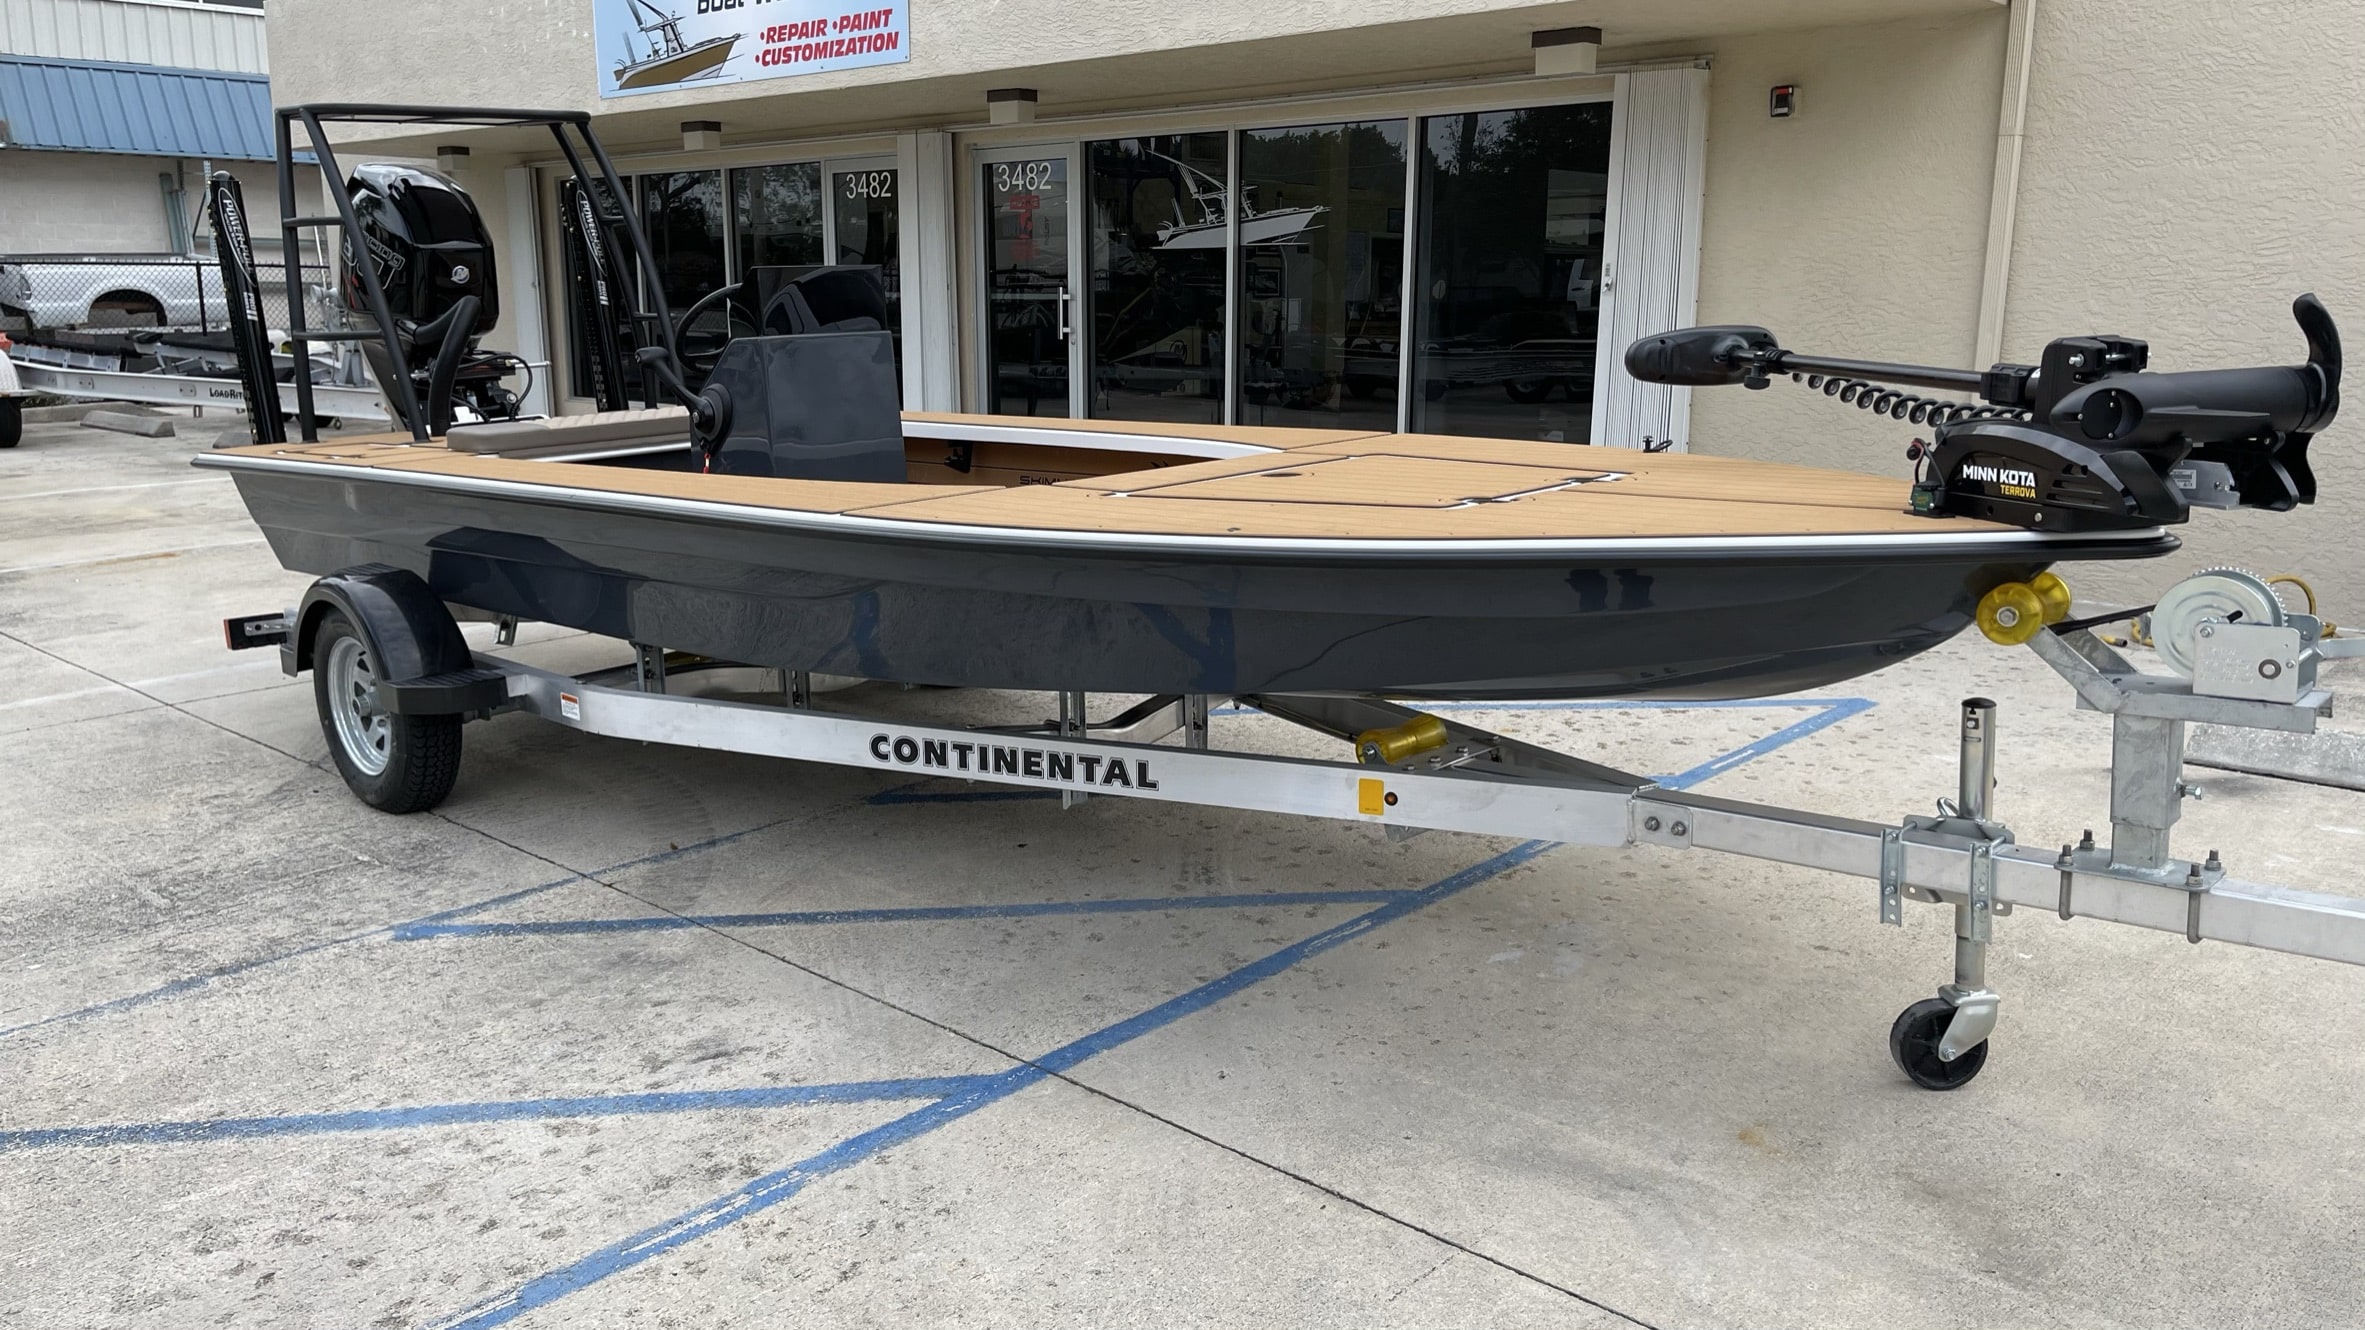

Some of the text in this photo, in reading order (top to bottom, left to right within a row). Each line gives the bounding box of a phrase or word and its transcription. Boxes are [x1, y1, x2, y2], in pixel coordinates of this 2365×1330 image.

[762, 31, 899, 67] CUSTOMIZATION
[846, 171, 892, 199] 3482
[999, 162, 1051, 192] 3482
[209, 386, 243, 400] LOADRIT
[1962, 464, 2036, 488] MINN KOTA
[2000, 484, 2036, 499] TERROVA
[869, 733, 1159, 791] CONTINENTAL
